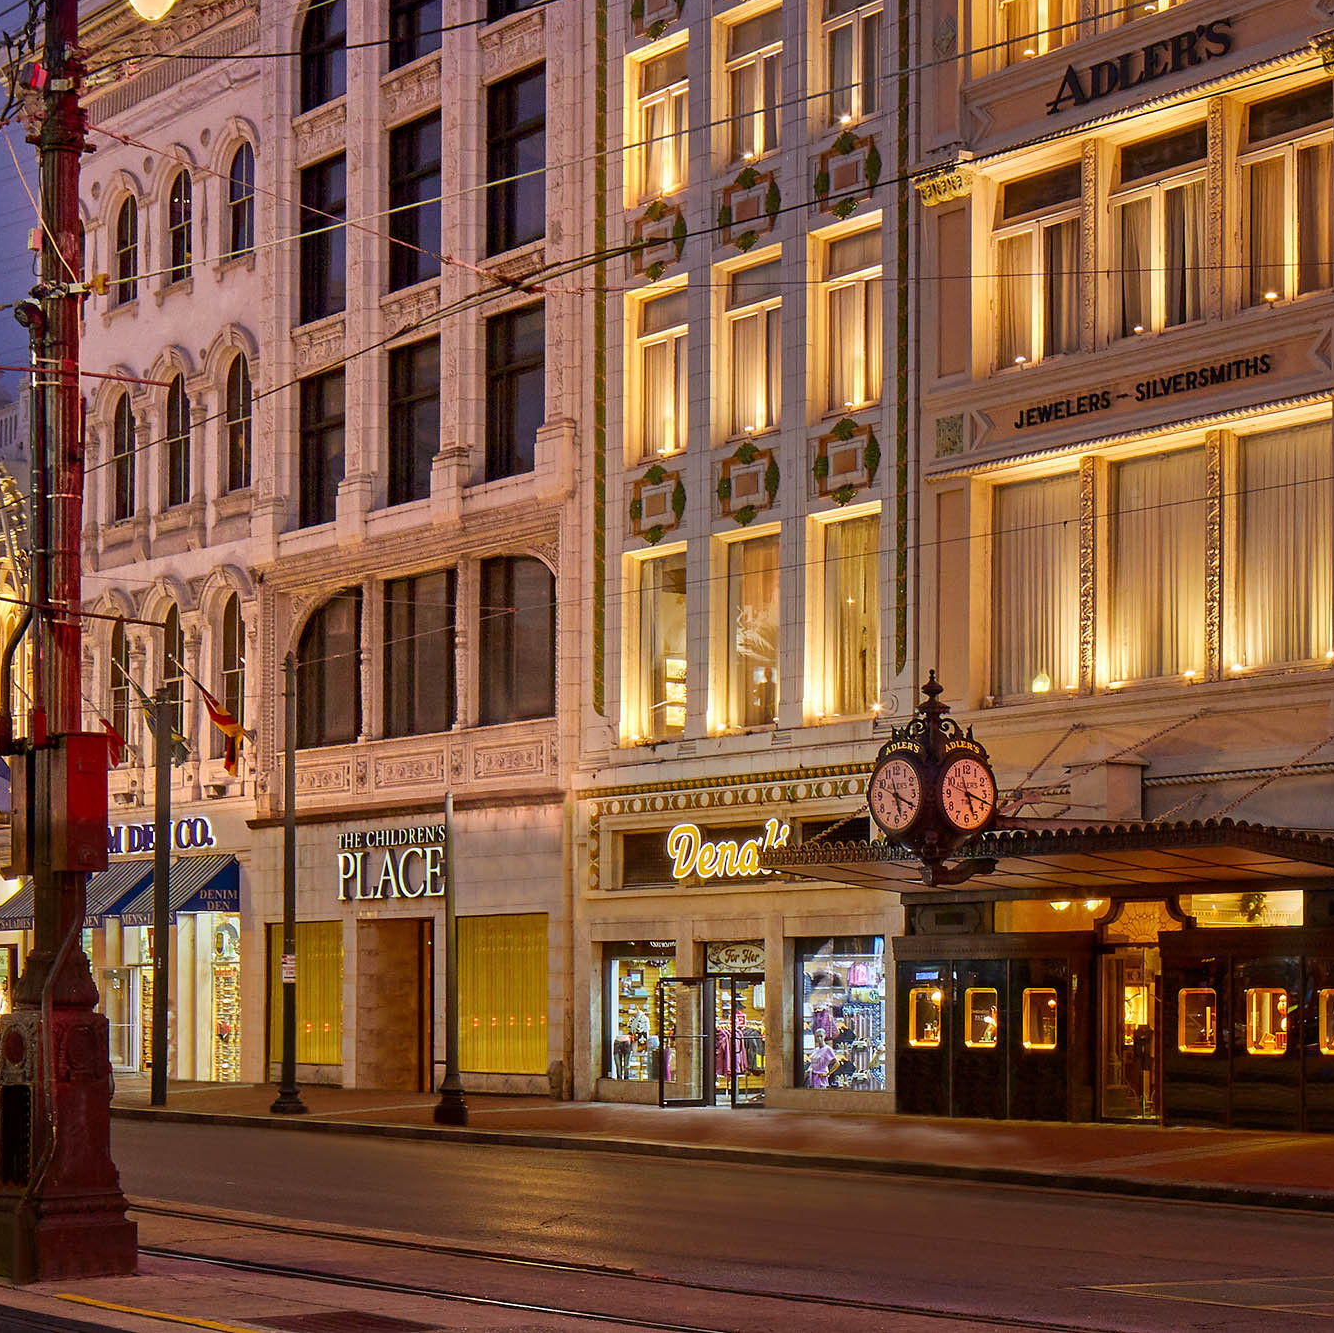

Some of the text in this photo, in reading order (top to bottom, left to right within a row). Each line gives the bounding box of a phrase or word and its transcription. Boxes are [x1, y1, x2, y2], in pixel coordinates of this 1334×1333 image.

[1045, 17, 1232, 116] ADLER'S
[1013, 389, 1111, 429] JEWELERS
[1134, 353, 1272, 403] SILVERSMITHS
[885, 741, 921, 756] ADLER'S
[945, 740, 980, 754] ADLER'S
[175, 817, 215, 850] CO.
[337, 825, 446, 849] THE CHILDREN'S
[337, 846, 446, 901] PLACE
[199, 889, 238, 900] DENIM
[207, 901, 230, 911] DEN
[724, 948, 760, 964] For Her
